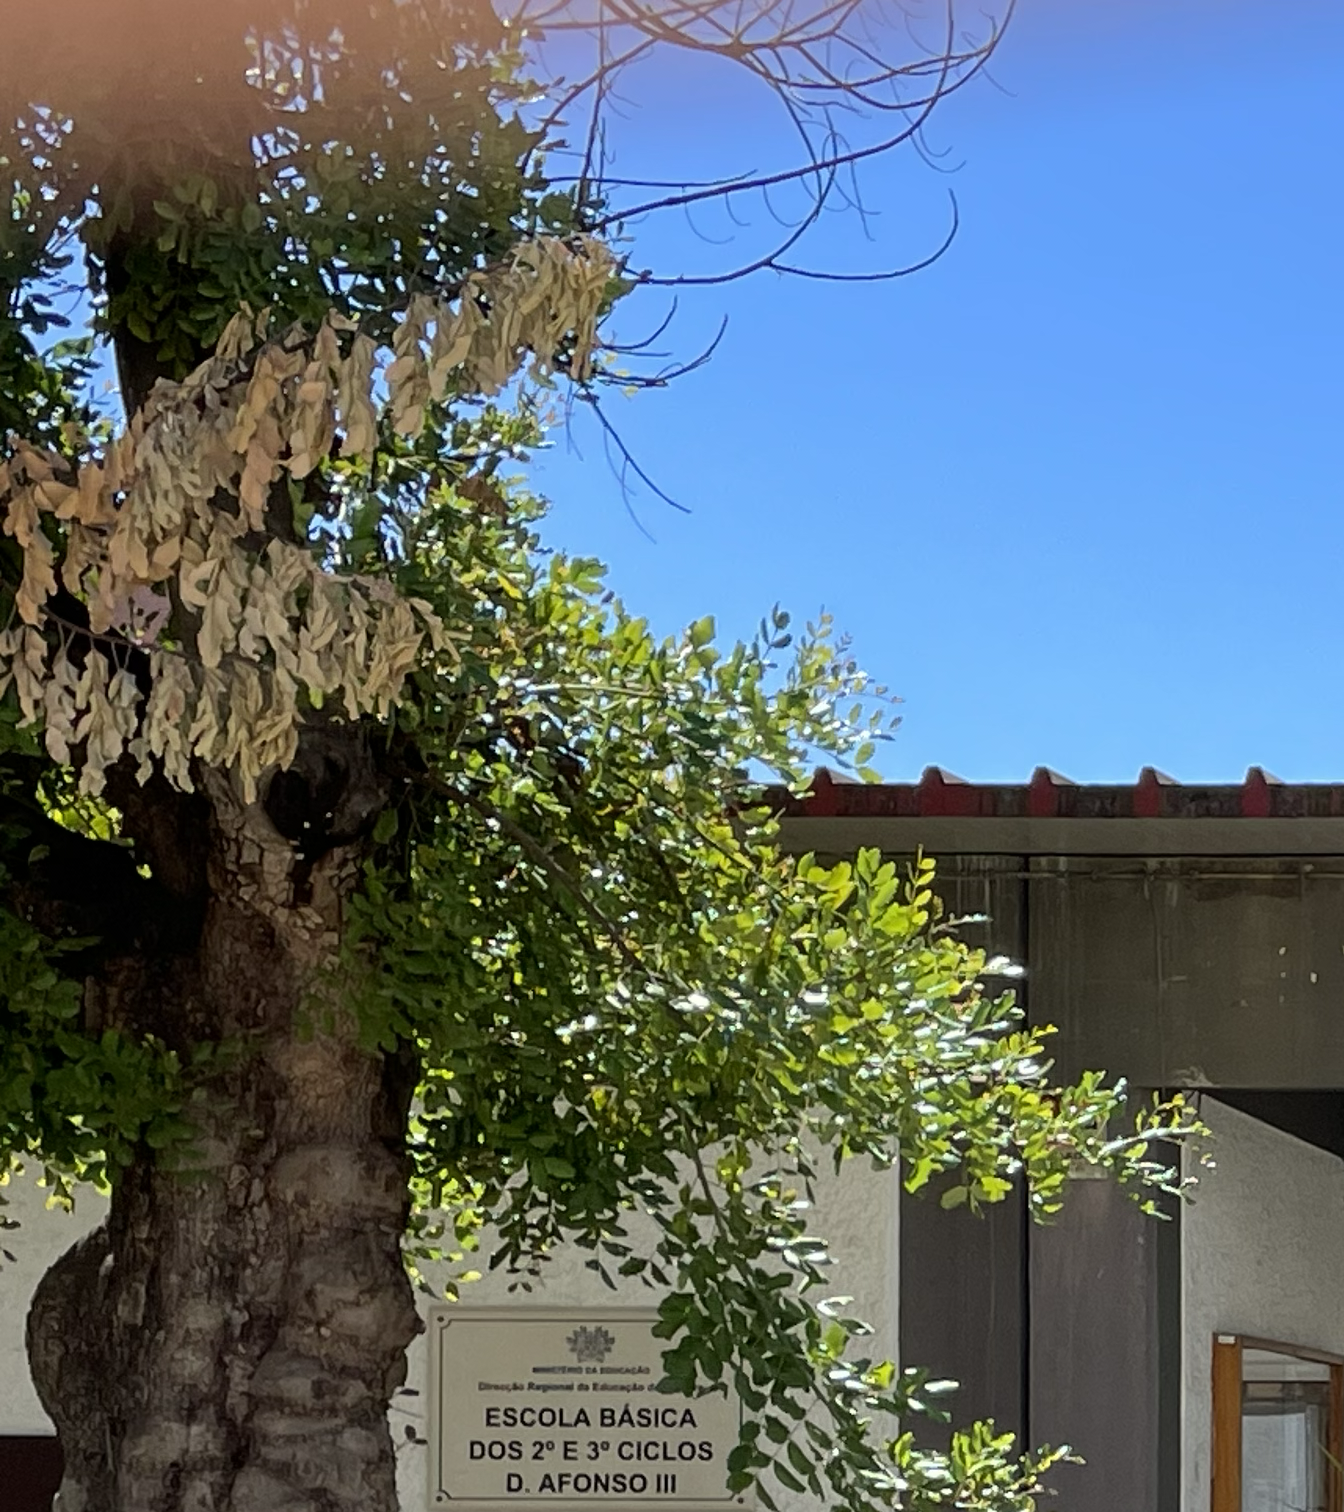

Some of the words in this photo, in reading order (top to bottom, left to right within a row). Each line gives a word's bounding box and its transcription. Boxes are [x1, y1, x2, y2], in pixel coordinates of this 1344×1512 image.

[527, 1382, 574, 1393] Regional
[592, 1382, 644, 1393] Educação
[485, 1407, 591, 1428] ESCOLA
[600, 1403, 697, 1428] BÁSICA
[469, 1440, 523, 1461] DOS
[563, 1441, 578, 1461] E
[617, 1440, 714, 1461] CICLOS
[506, 1473, 530, 1494] D.
[538, 1473, 648, 1494] AFONSO
[656, 1473, 677, 1494] III
